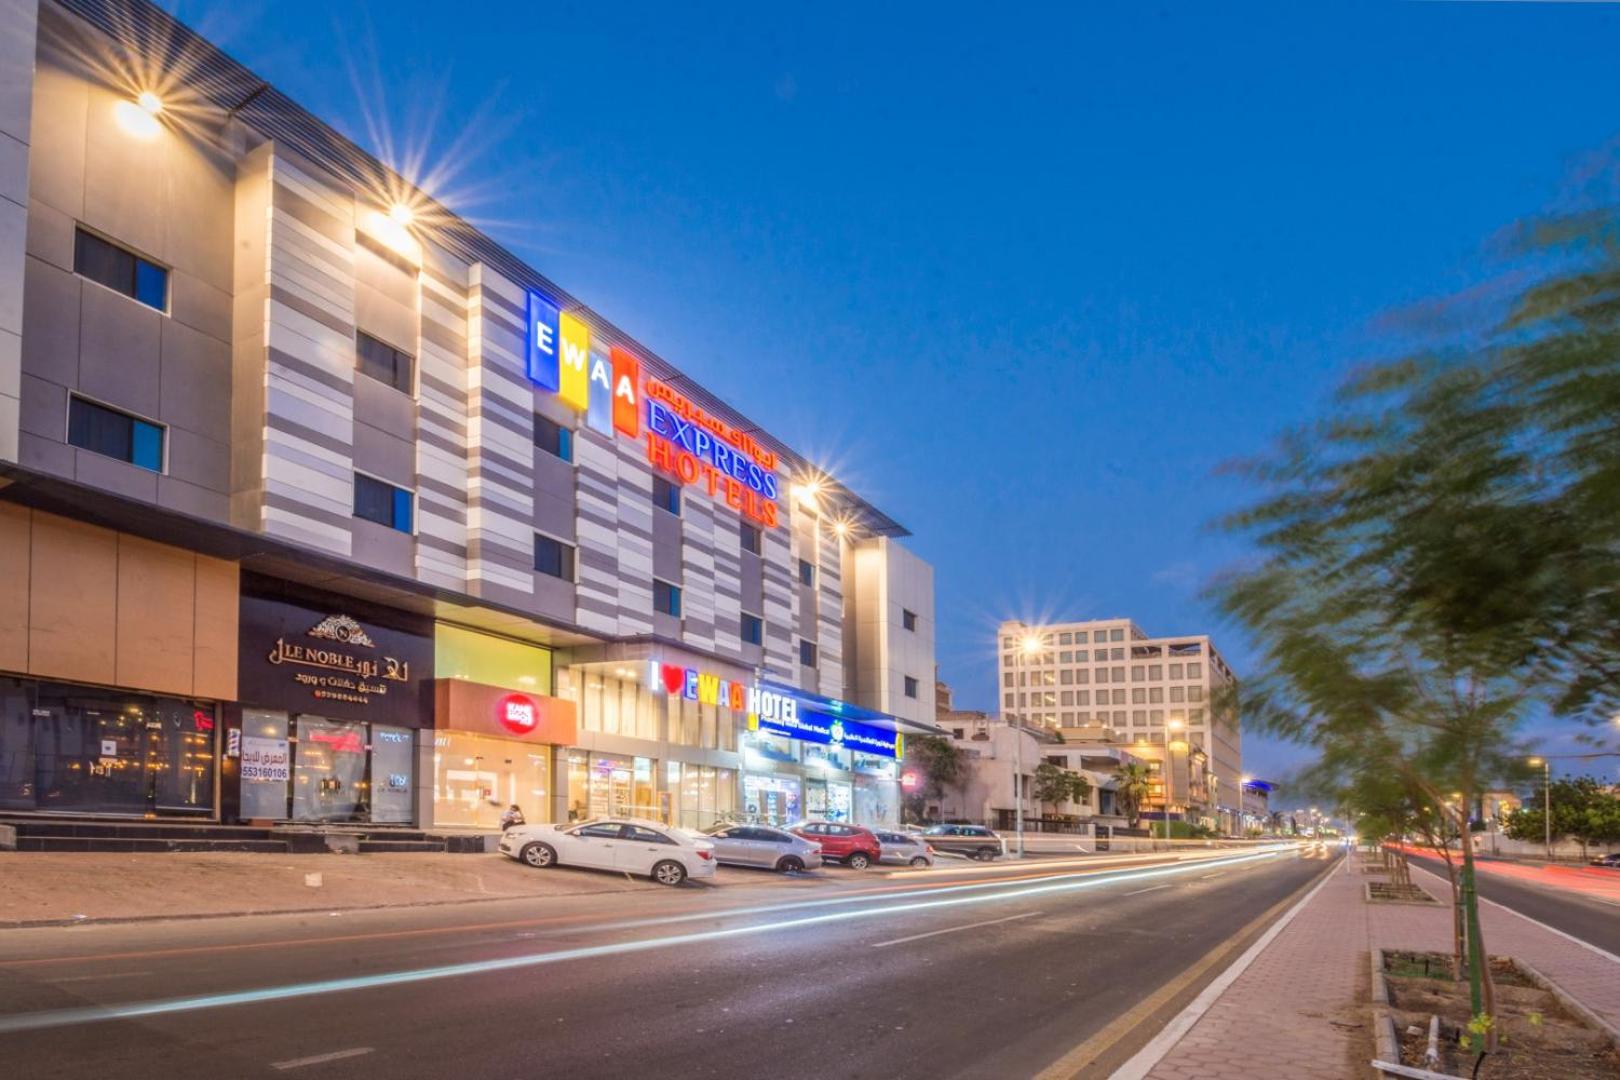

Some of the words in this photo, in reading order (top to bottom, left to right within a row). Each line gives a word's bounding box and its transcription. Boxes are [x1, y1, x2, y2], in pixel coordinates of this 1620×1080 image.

[537, 321, 635, 405] EWAA
[646, 399, 778, 500] EXPRESS
[647, 431, 778, 528] HOTELS
[285, 644, 302, 658] LE
[306, 648, 355, 668] NOBLE
[651, 660, 659, 691] I
[685, 668, 745, 713] EWAA
[748, 687, 797, 722] HOTEL
